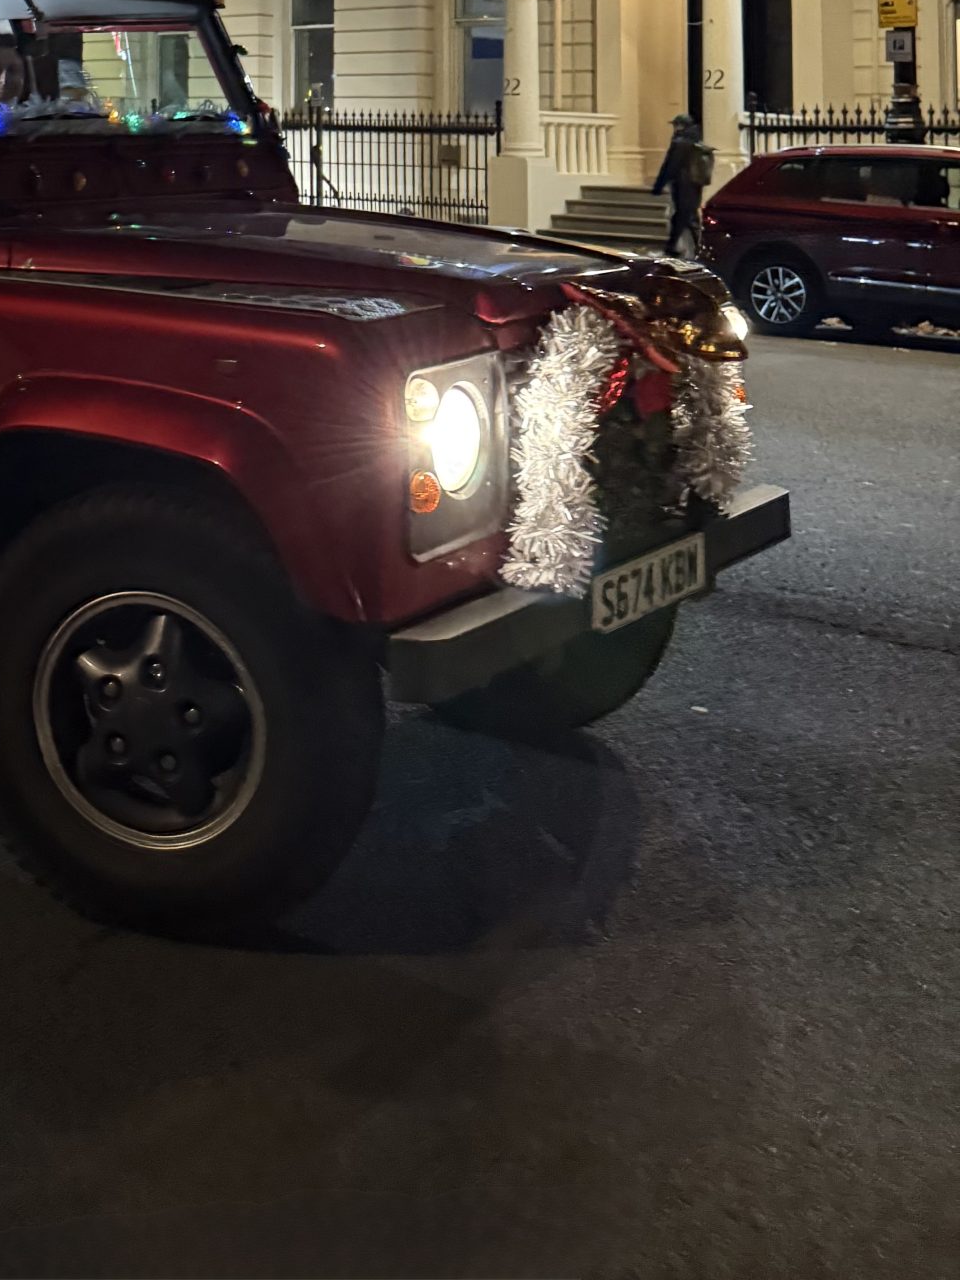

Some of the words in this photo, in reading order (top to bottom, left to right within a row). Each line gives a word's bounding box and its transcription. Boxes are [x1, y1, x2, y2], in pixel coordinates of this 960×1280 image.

[503, 78, 520, 96] 22
[703, 69, 724, 90] 22
[602, 562, 654, 627] S674
